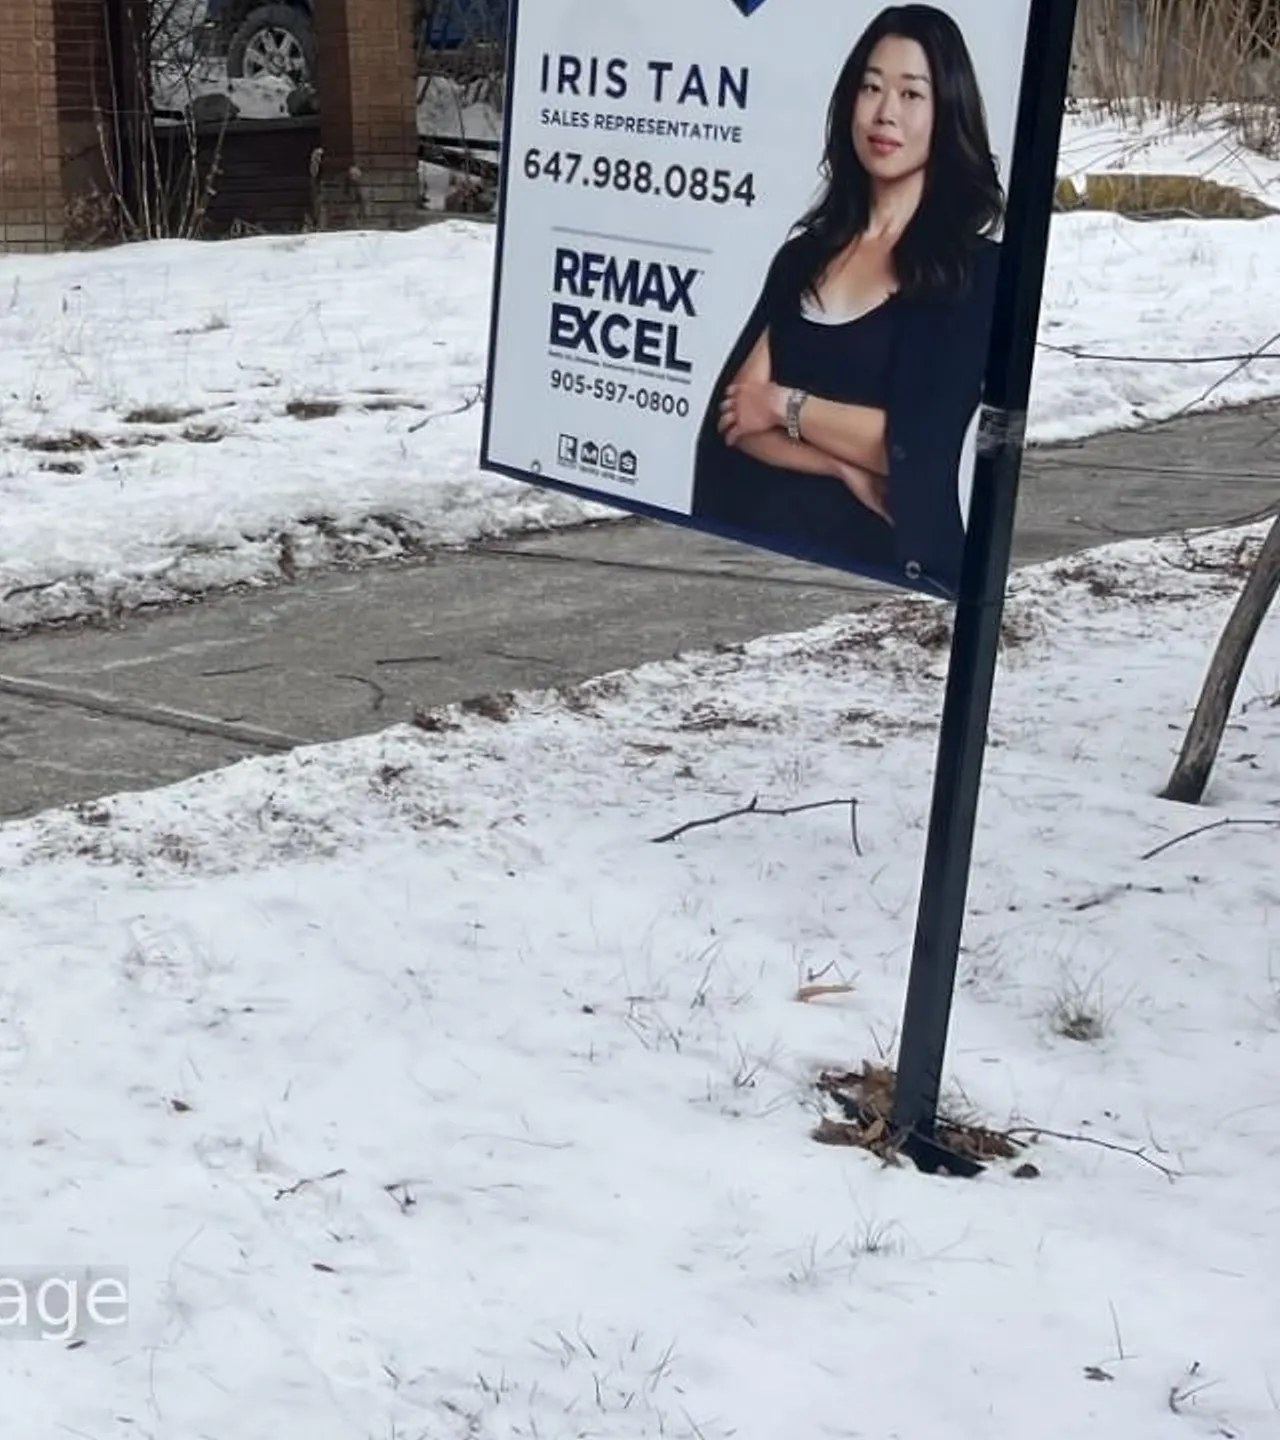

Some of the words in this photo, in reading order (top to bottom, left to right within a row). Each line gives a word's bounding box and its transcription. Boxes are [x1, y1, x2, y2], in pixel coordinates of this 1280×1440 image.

[540, 53, 628, 99] IRIS
[648, 61, 749, 110] TAN
[540, 109, 590, 129] SALES
[594, 113, 743, 144] REPRESENTATIVE
[523, 148, 756, 207] 647.988.0854
[550, 302, 693, 373] EXCEL
[550, 369, 689, 417] 905-597-0800
